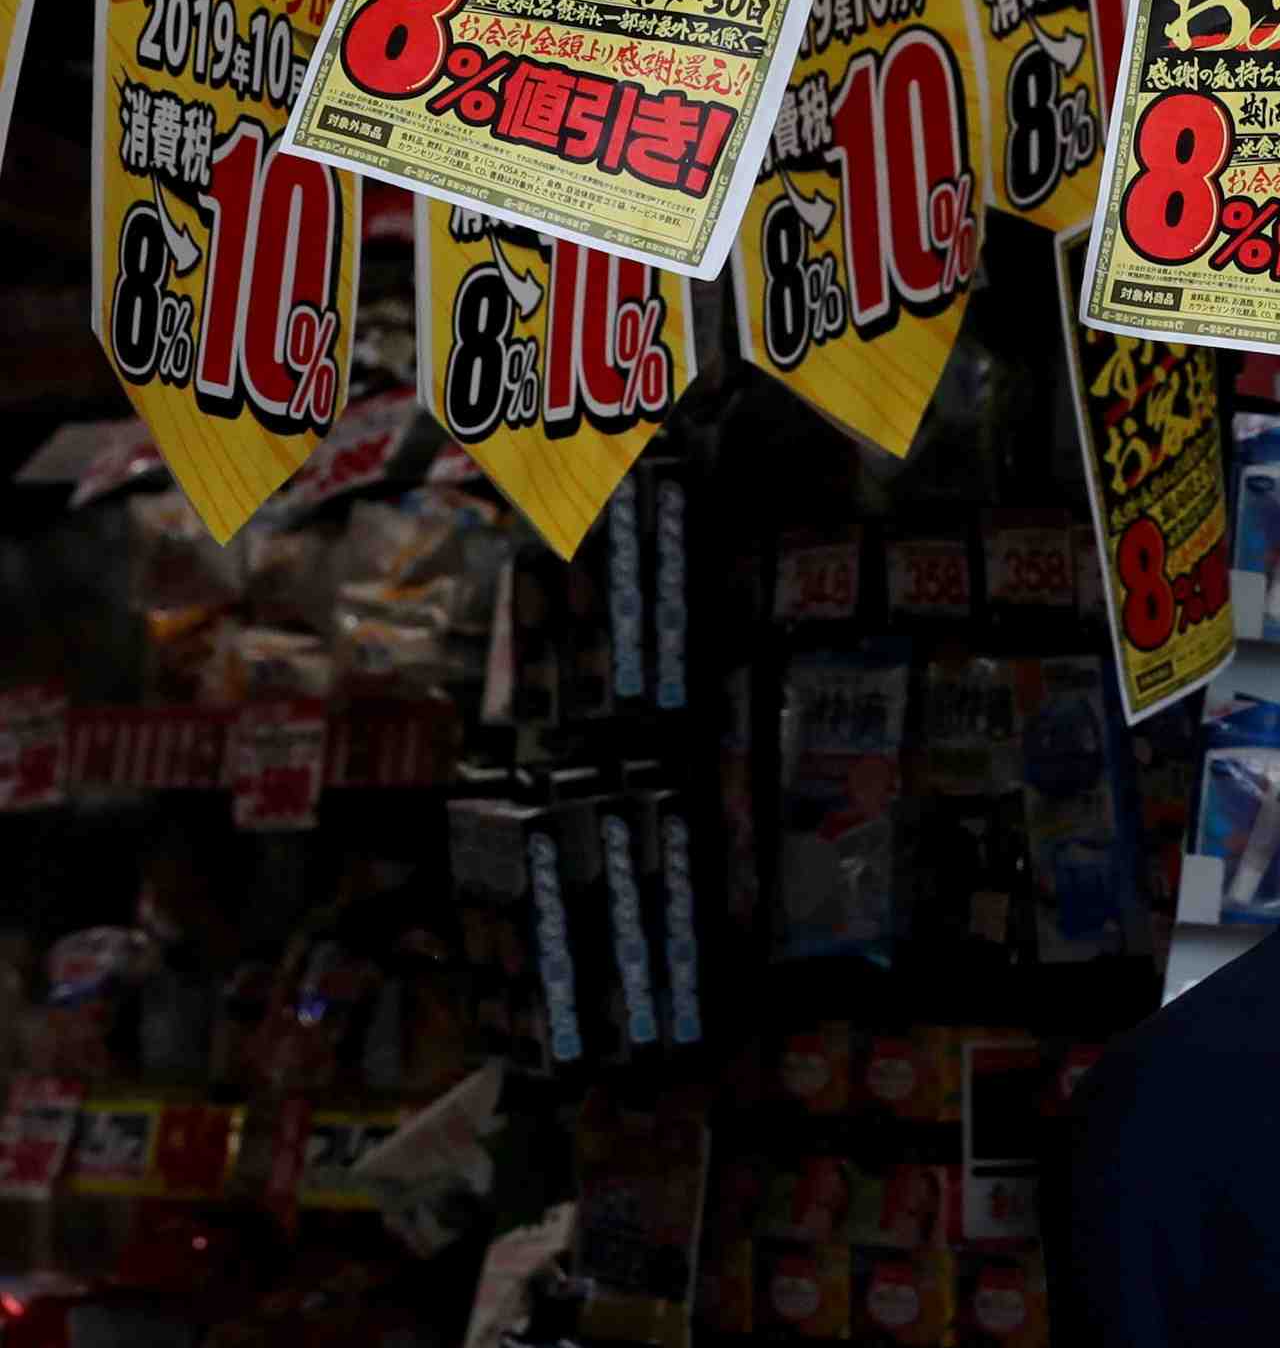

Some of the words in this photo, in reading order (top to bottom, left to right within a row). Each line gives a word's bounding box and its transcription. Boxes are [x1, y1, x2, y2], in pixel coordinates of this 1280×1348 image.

[121, 89, 213, 185] 消費税
[832, 30, 976, 324] 10%
[1006, 40, 1094, 208] 8%
[112, 206, 193, 379] 8%
[198, 119, 337, 424] 10%
[446, 266, 538, 434] 8%
[764, 208, 844, 367] 8%
